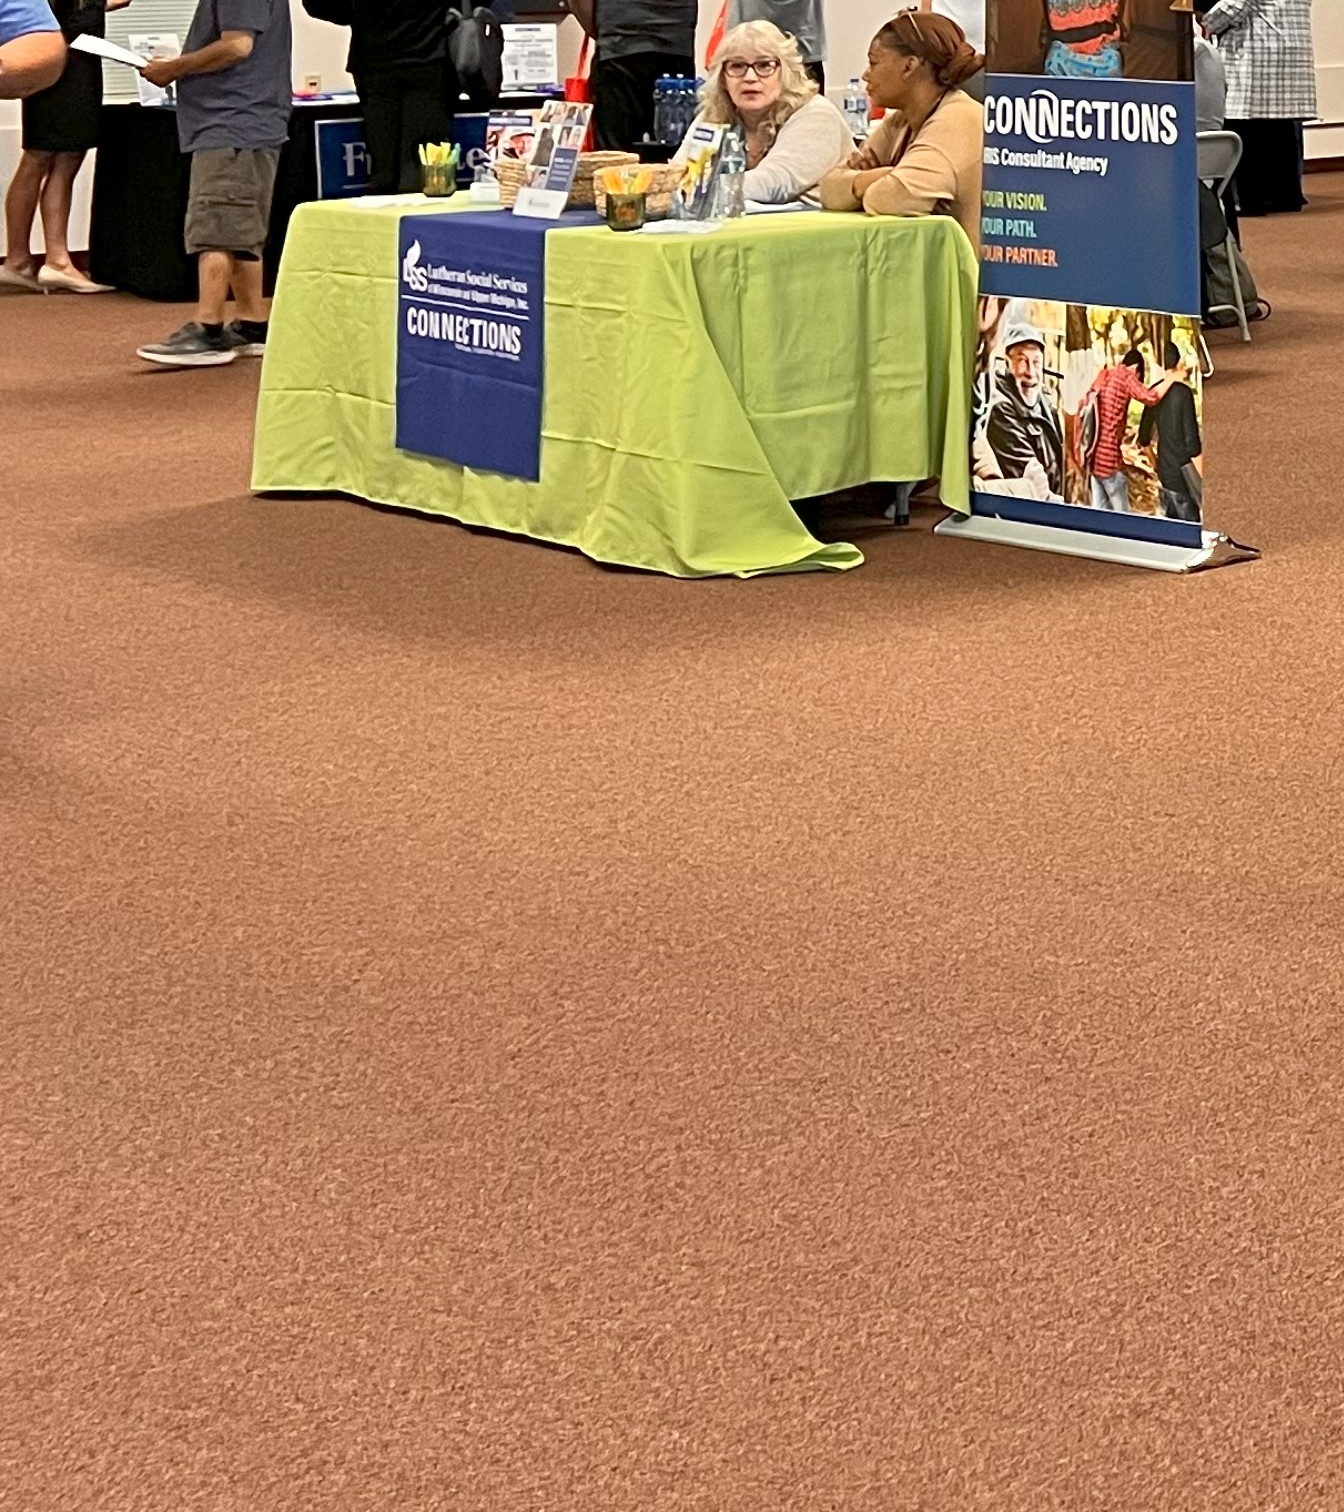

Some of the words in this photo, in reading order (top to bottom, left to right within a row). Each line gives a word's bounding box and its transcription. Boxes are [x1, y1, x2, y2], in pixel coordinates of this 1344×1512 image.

[984, 90, 1178, 145] CONNECTIONS
[1001, 148, 1065, 169] Consultant
[1066, 152, 1108, 176] Agency
[1006, 192, 1047, 211] VISION.
[1005, 219, 1037, 238] PATH.
[1005, 246, 1058, 267] PARTNER.
[428, 263, 466, 284] Lutheran
[466, 270, 492, 288] Social
[493, 274, 528, 294] Services
[407, 307, 521, 354] CONNECTIONS
